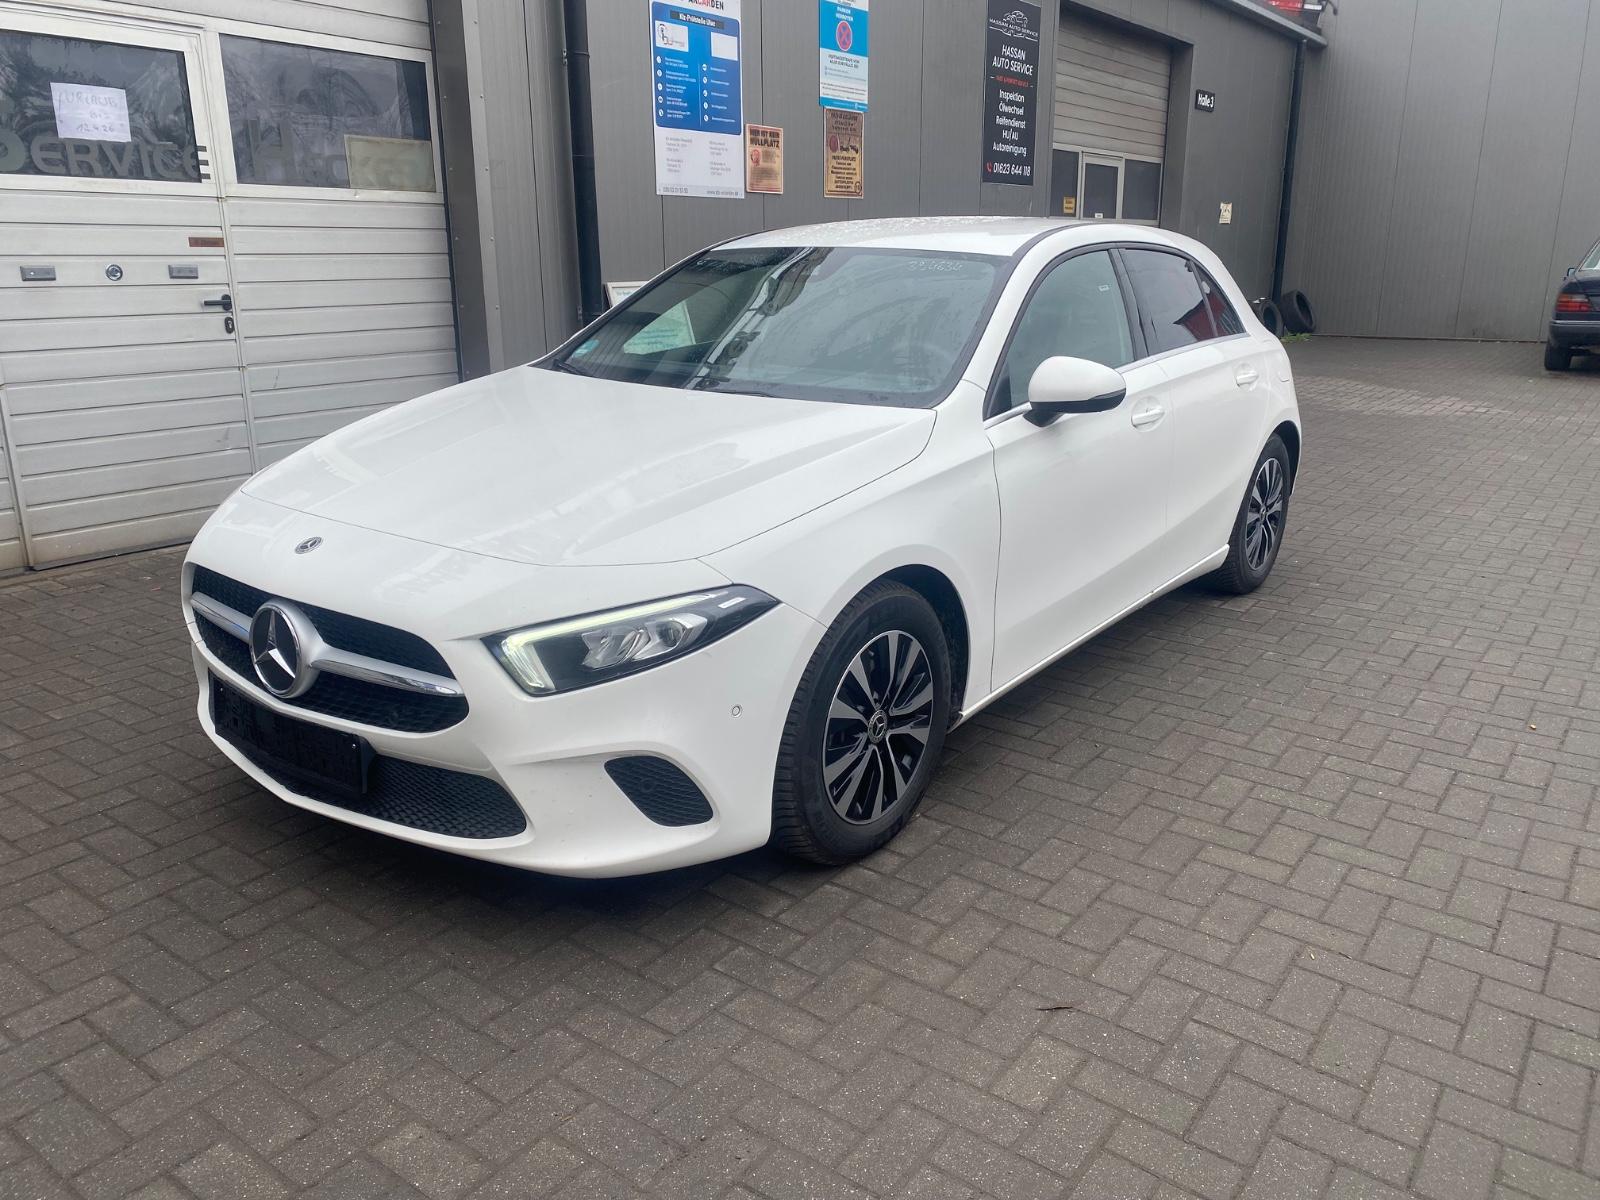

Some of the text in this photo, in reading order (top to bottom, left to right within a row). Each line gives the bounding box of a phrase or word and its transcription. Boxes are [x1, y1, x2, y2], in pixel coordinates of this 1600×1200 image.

[989, 18, 1039, 38] HASSAN AUTO SERVICE
[1001, 44, 1026, 61] HASSAN
[992, 55, 1034, 76] AUTO SERVICE
[999, 89, 1025, 103] Inspektion
[1197, 93, 1210, 107] Halle
[999, 101, 1025, 115] Ölwechsel
[995, 115, 1026, 129] Reifendienst
[992, 141, 1027, 157] Autoreinigung
[993, 162, 1010, 175] 01623
[1011, 164, 1022, 176] 644
